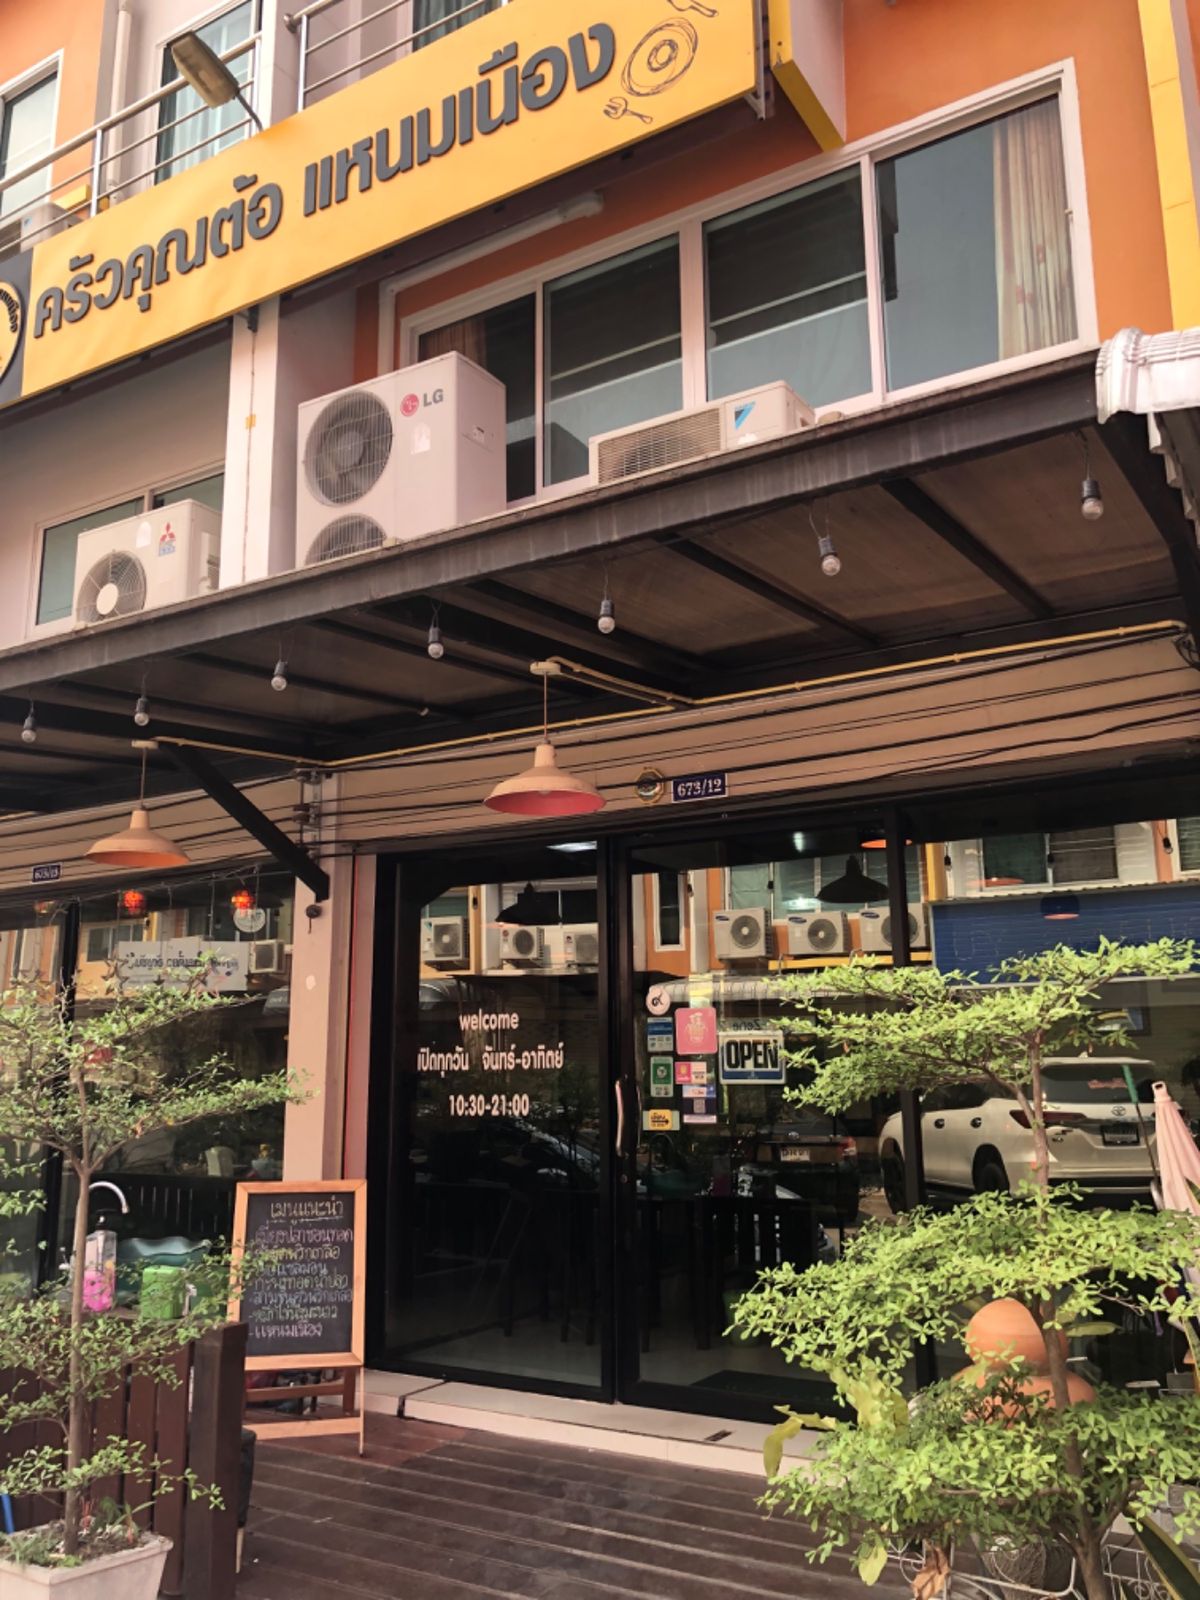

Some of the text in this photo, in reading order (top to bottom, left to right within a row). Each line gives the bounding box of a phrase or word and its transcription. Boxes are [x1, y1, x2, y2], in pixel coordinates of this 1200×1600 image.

[34, 22, 617, 339] ครัวคุณต้อ แหนมเนือง
[423, 388, 444, 407] LG
[677, 778, 722, 798] 673/12
[459, 1008, 519, 1030] welcome
[416, 1042, 564, 1078] เปิดทุกวัน จันทร์-อาทิตย์
[727, 1040, 778, 1069] OPEN
[449, 1094, 530, 1117] 10:30-21:00
